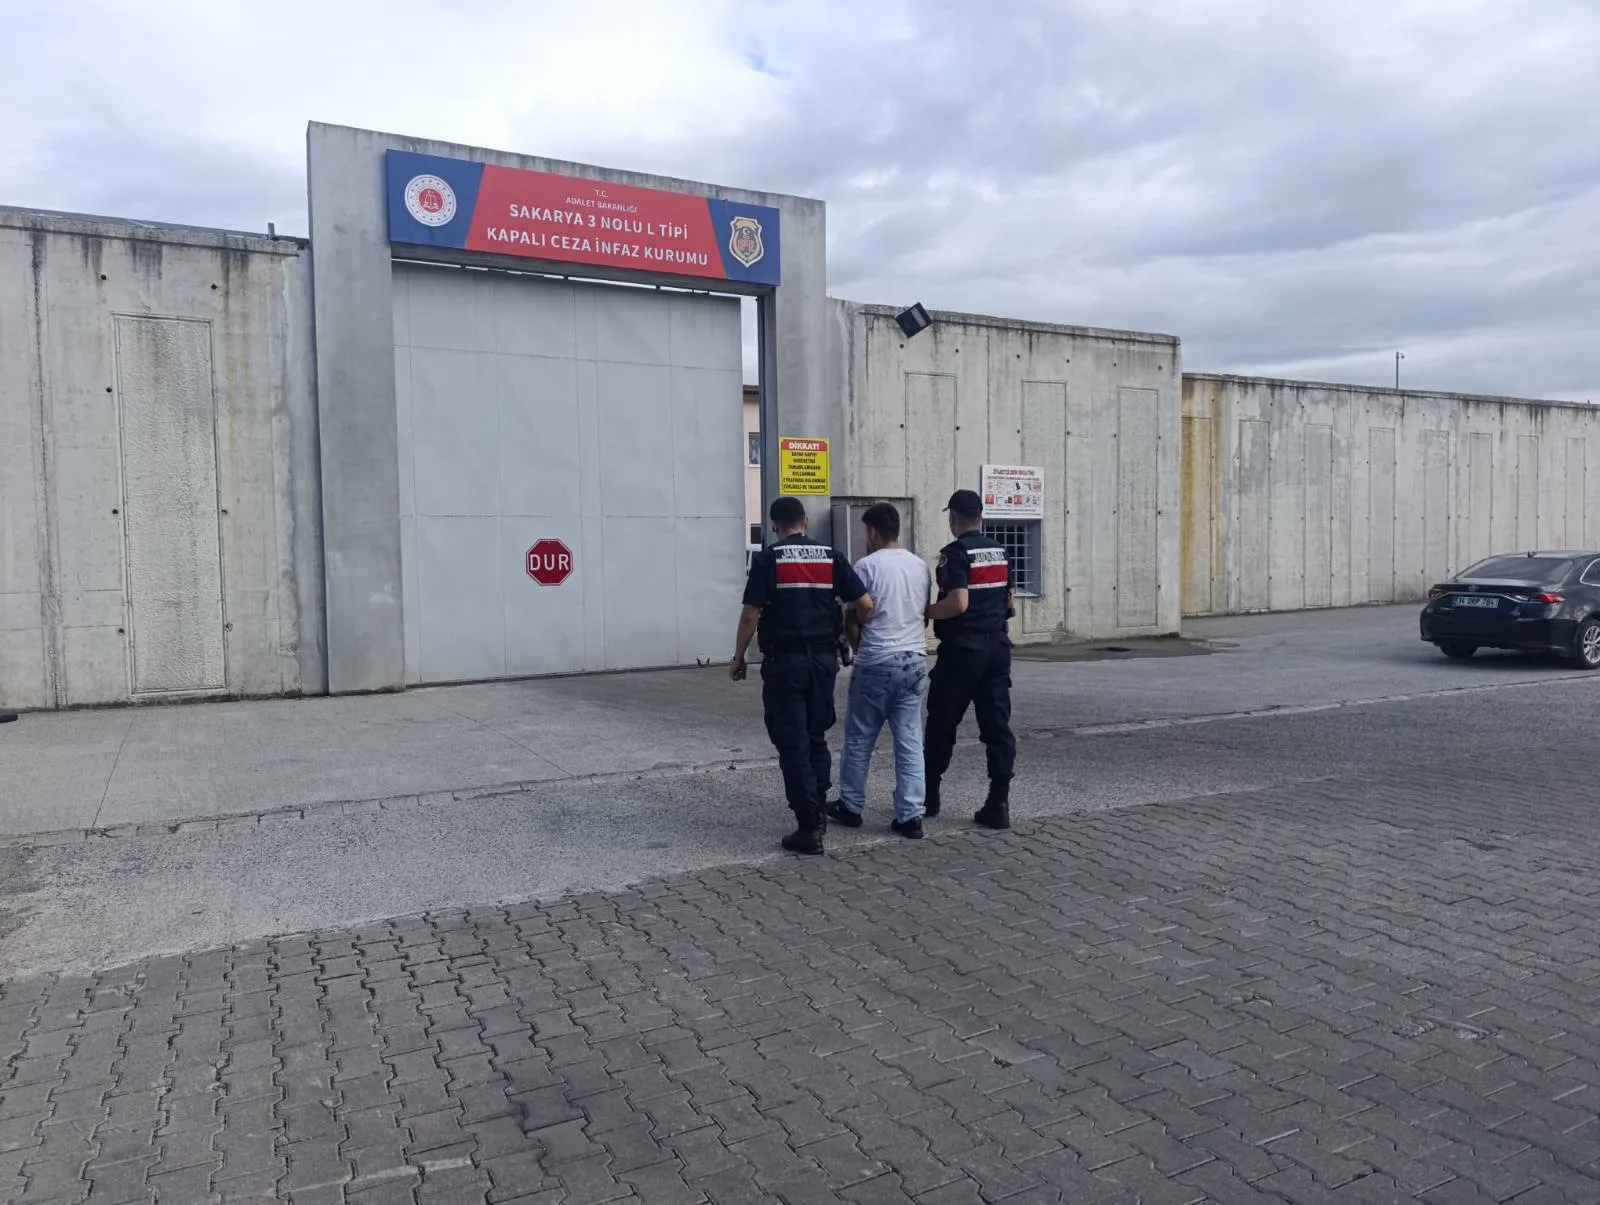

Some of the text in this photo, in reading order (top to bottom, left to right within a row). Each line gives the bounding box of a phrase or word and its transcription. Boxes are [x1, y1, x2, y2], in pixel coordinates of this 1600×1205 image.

[594, 189, 608, 197] T.C.
[566, 197, 638, 213] ADALET BAKANLIĞI
[510, 204, 688, 240] SAKARYA 3 NOLU L TİPİ
[488, 227, 708, 265] KAPALI CEZA İNFAZ KURUMU
[789, 441, 820, 450] DİKKAT!
[530, 554, 569, 571] DUR
[781, 548, 828, 561] JANDARMA
